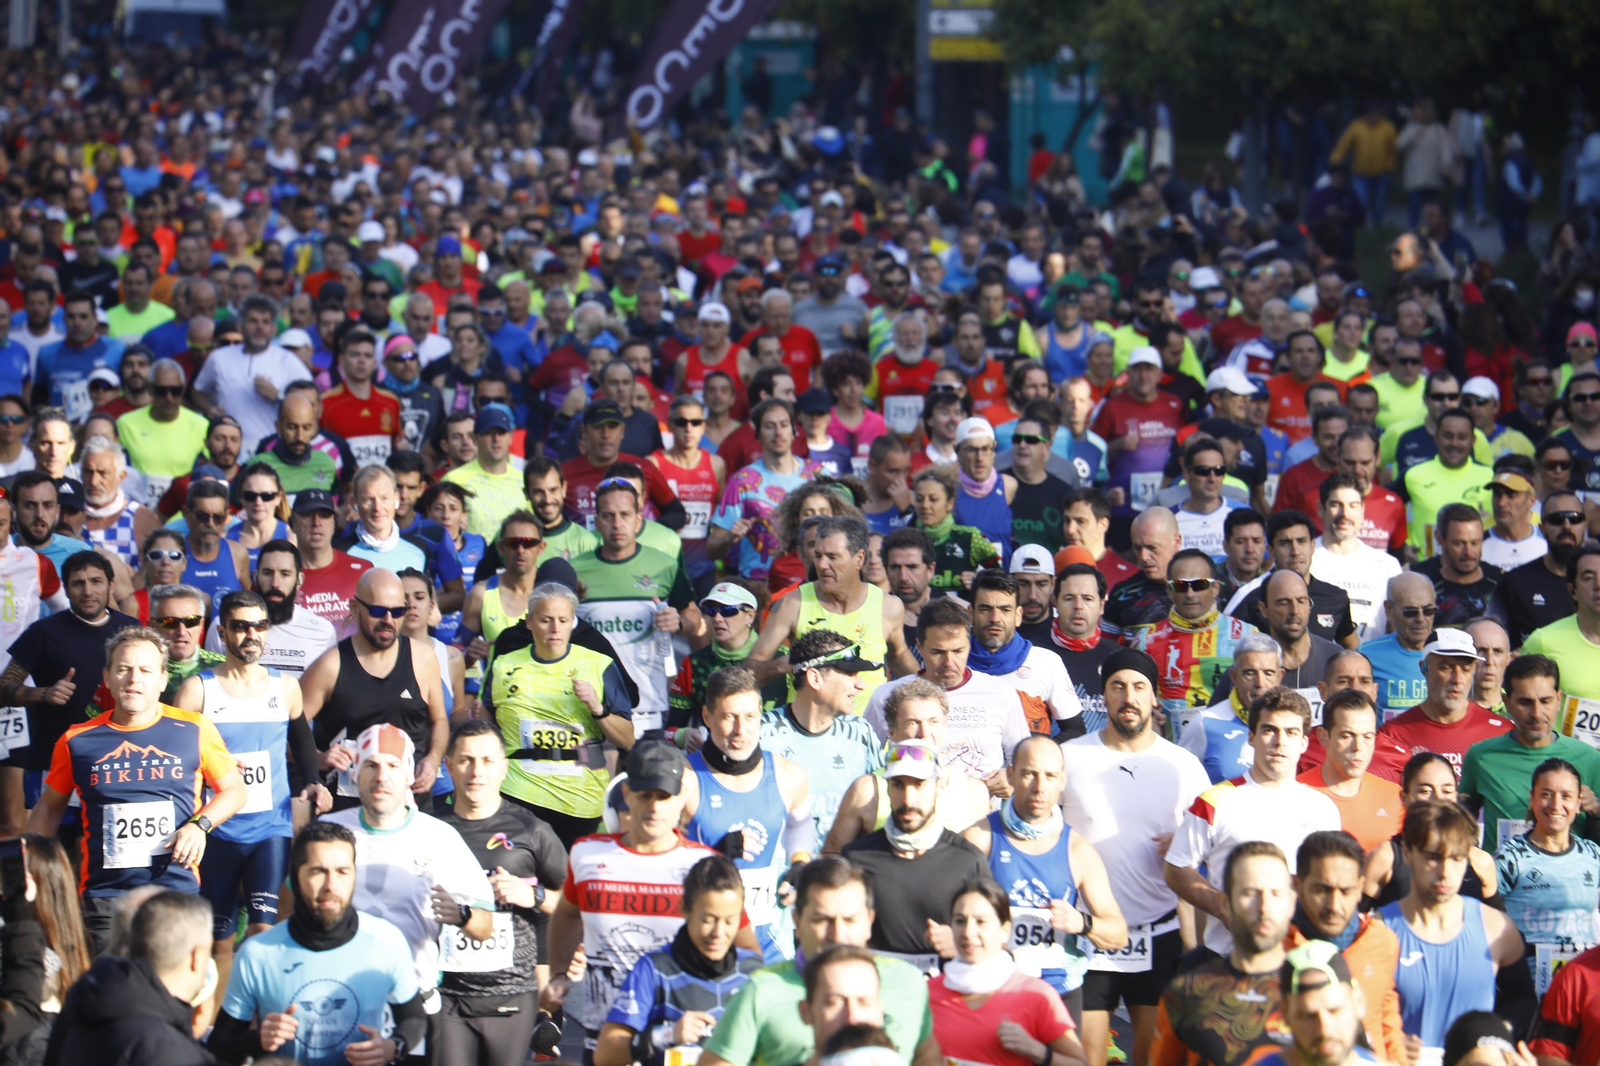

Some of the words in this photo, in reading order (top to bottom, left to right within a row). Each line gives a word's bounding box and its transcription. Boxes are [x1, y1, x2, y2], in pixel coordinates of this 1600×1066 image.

[305, 592, 340, 604] MEDIA
[533, 730, 580, 749] 3395
[91, 762, 131, 772] MORE
[141, 758, 182, 767] THAN
[89, 766, 185, 786] BIKING
[116, 816, 170, 839] 2656
[604, 883, 636, 893] MEDIA
[1014, 923, 1056, 947] 954
